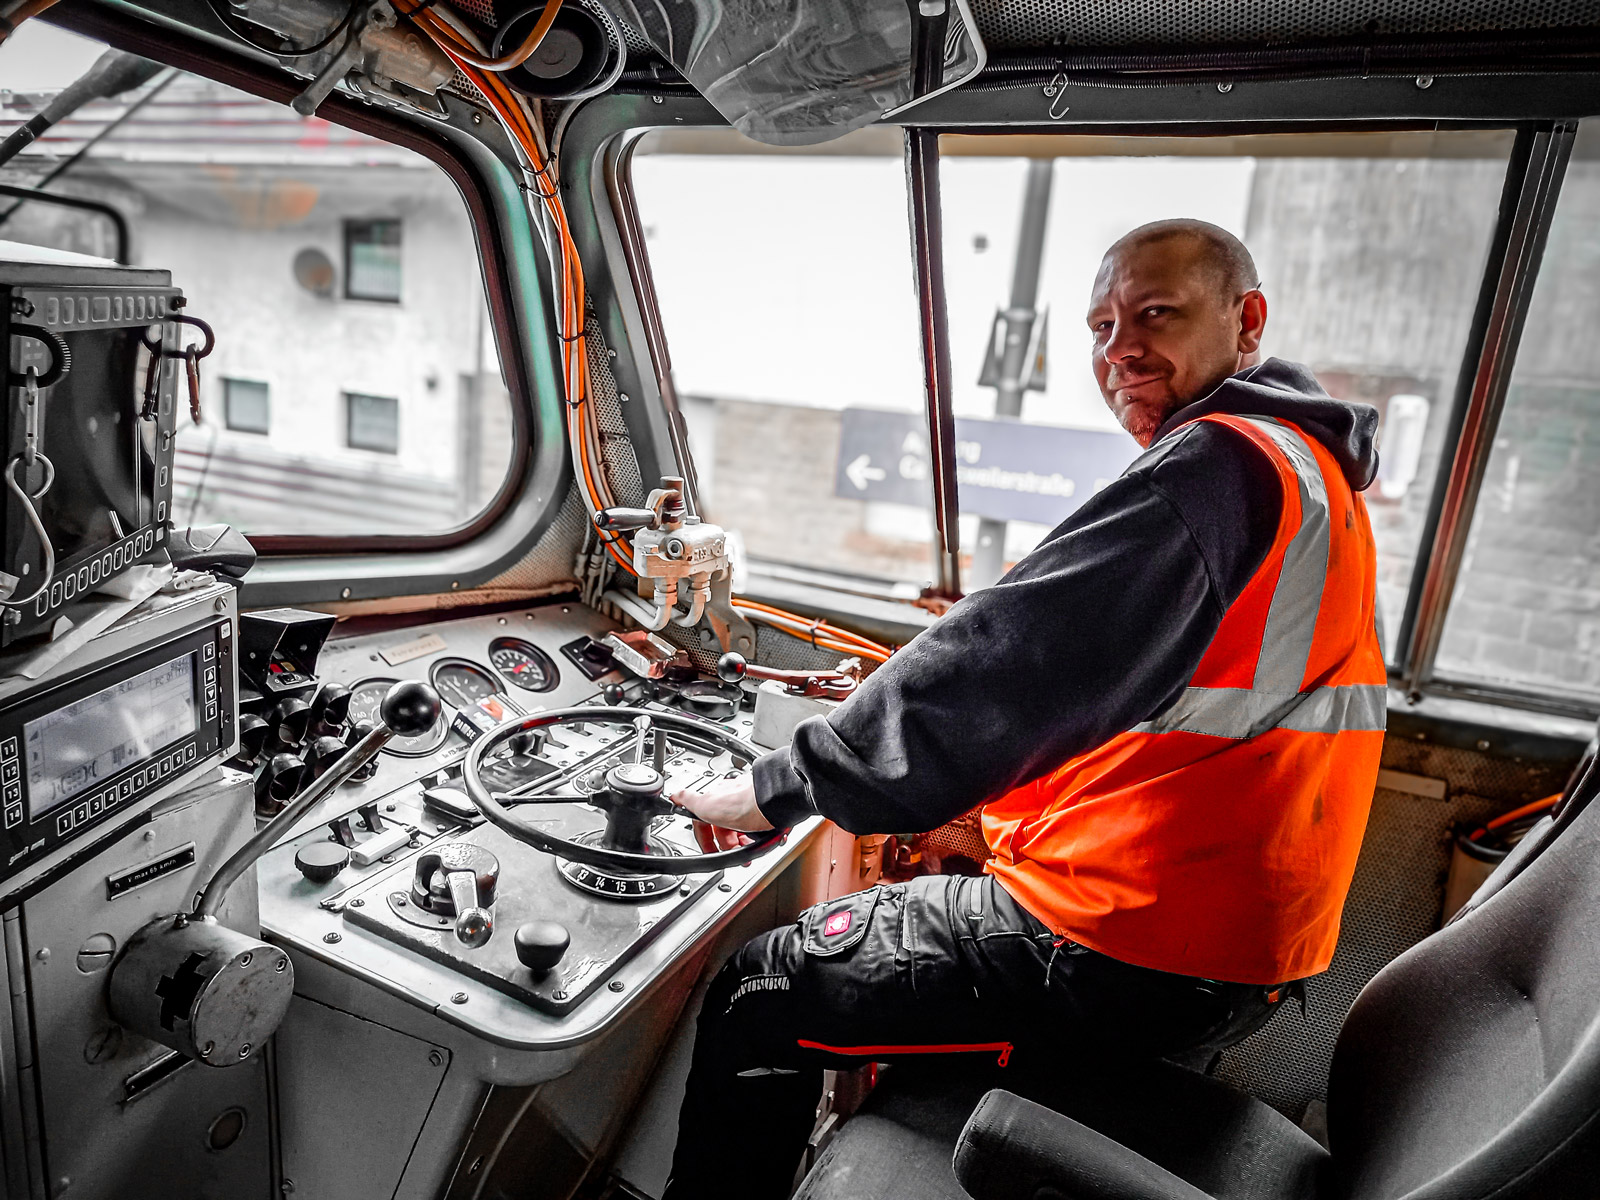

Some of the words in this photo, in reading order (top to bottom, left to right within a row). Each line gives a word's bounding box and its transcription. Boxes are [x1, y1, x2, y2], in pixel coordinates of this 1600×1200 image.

[4, 744, 14, 756] 11
[176, 755, 181, 764] 9
[164, 762, 169, 771] 8
[6, 766, 17, 778] 12
[151, 769, 156, 778] 7
[137, 777, 142, 786] 6
[8, 787, 19, 800] 13
[123, 785, 129, 794] 5
[108, 793, 114, 802] 4
[94, 802, 100, 810] 3
[9, 809, 20, 822] 14
[79, 811, 85, 819] 2
[63, 819, 68, 828] 1
[134, 870, 148, 880] max
[149, 866, 158, 874] 65
[159, 859, 177, 869] km/h
[577, 869, 588, 880] 13
[594, 876, 605, 888] 14
[615, 881, 627, 892] 15
[638, 881, 646, 892] B
